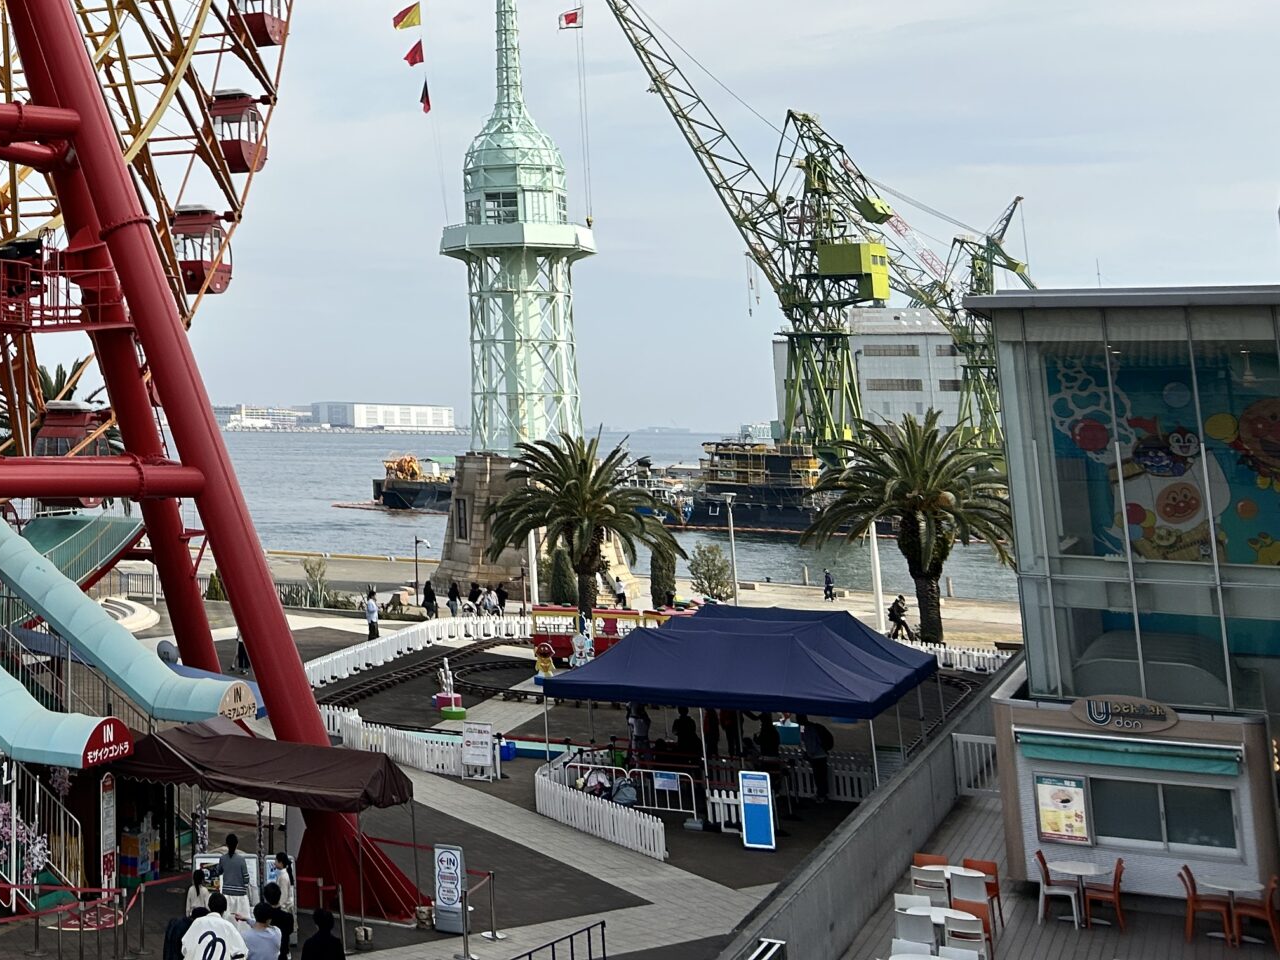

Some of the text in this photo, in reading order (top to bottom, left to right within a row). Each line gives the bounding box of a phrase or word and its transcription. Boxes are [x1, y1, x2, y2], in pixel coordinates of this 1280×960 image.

[233, 686, 242, 704] IN
[103, 723, 114, 744] IN
[87, 741, 130, 763] モザイクゴンドラ
[446, 857, 456, 867] IN
